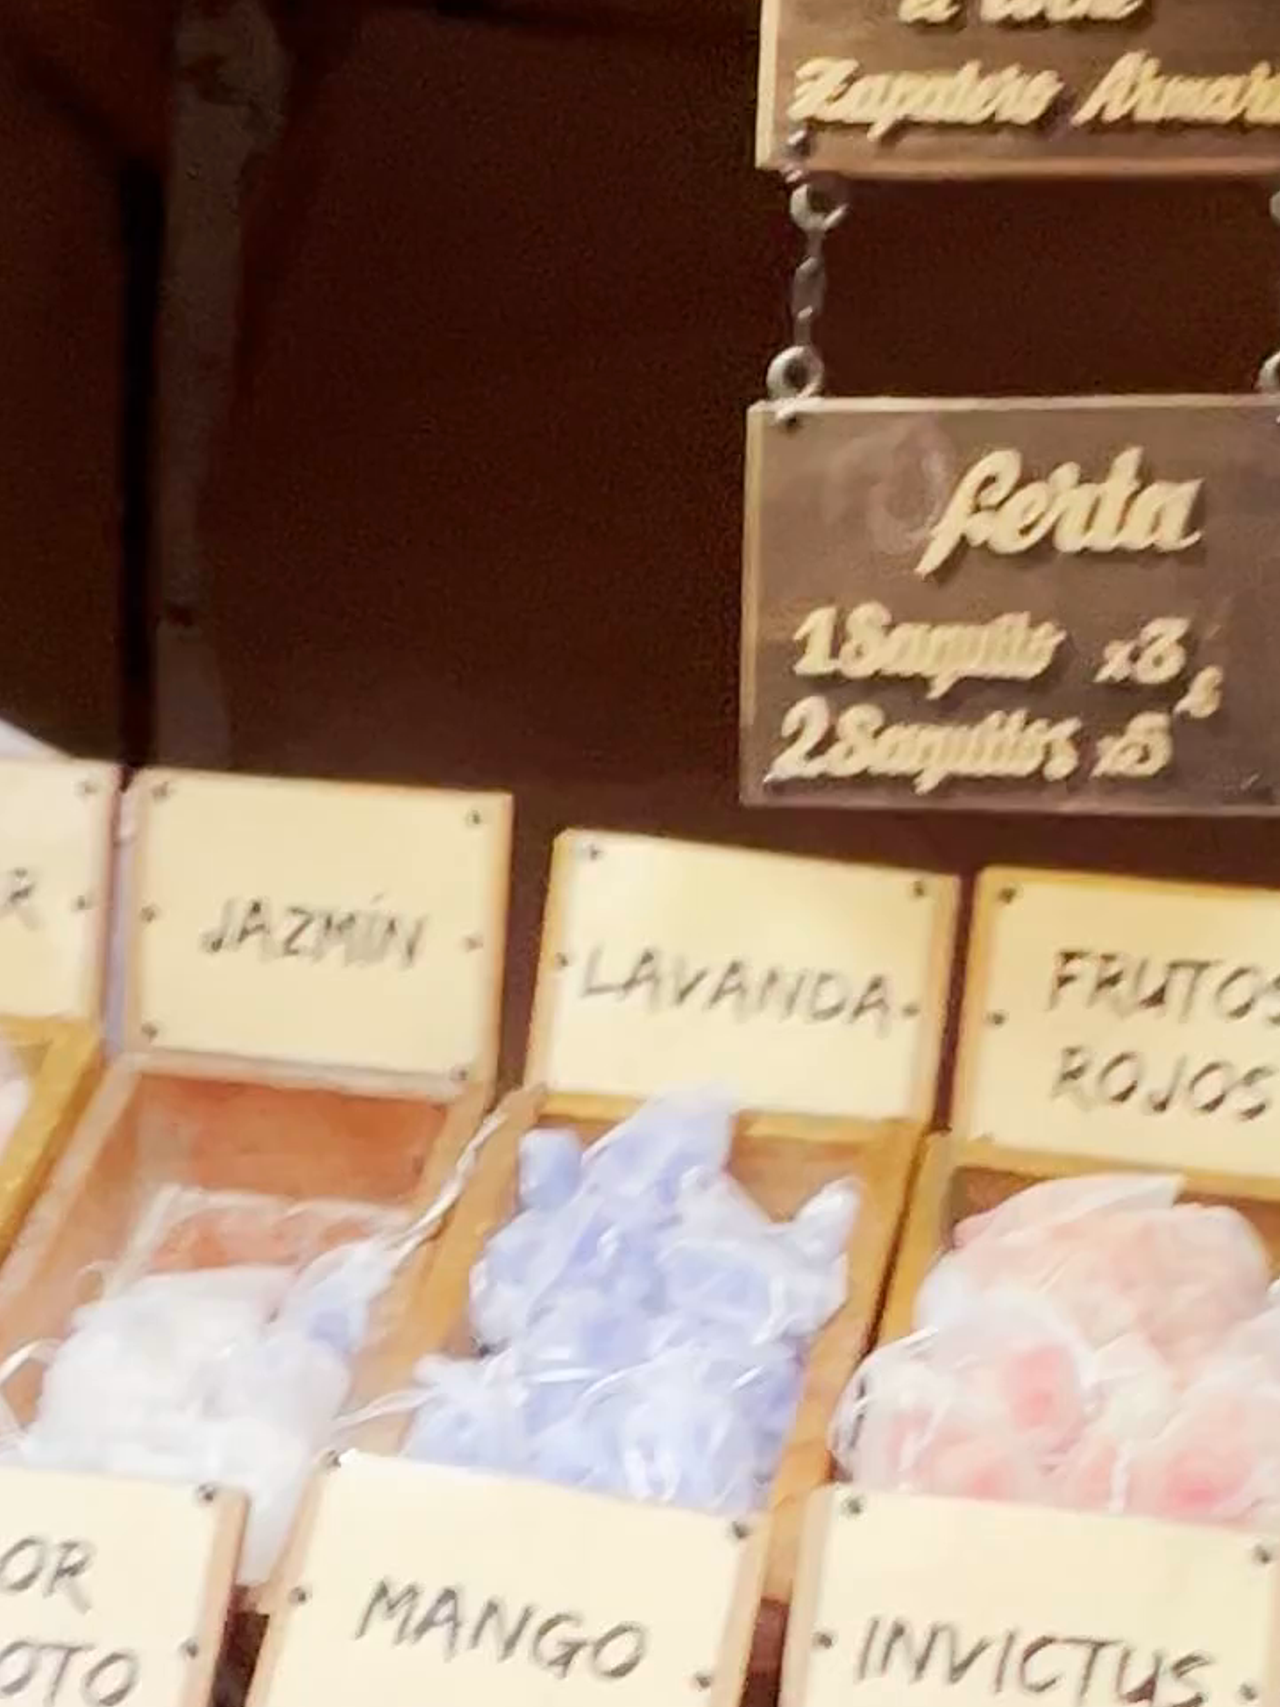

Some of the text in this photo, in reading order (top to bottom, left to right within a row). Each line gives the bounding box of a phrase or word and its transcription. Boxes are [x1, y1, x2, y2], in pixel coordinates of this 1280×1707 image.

[577, 940, 893, 1040] LAVANDA
[1050, 1044, 1279, 1123] ROJOS
[355, 1577, 652, 1683] MANGO
